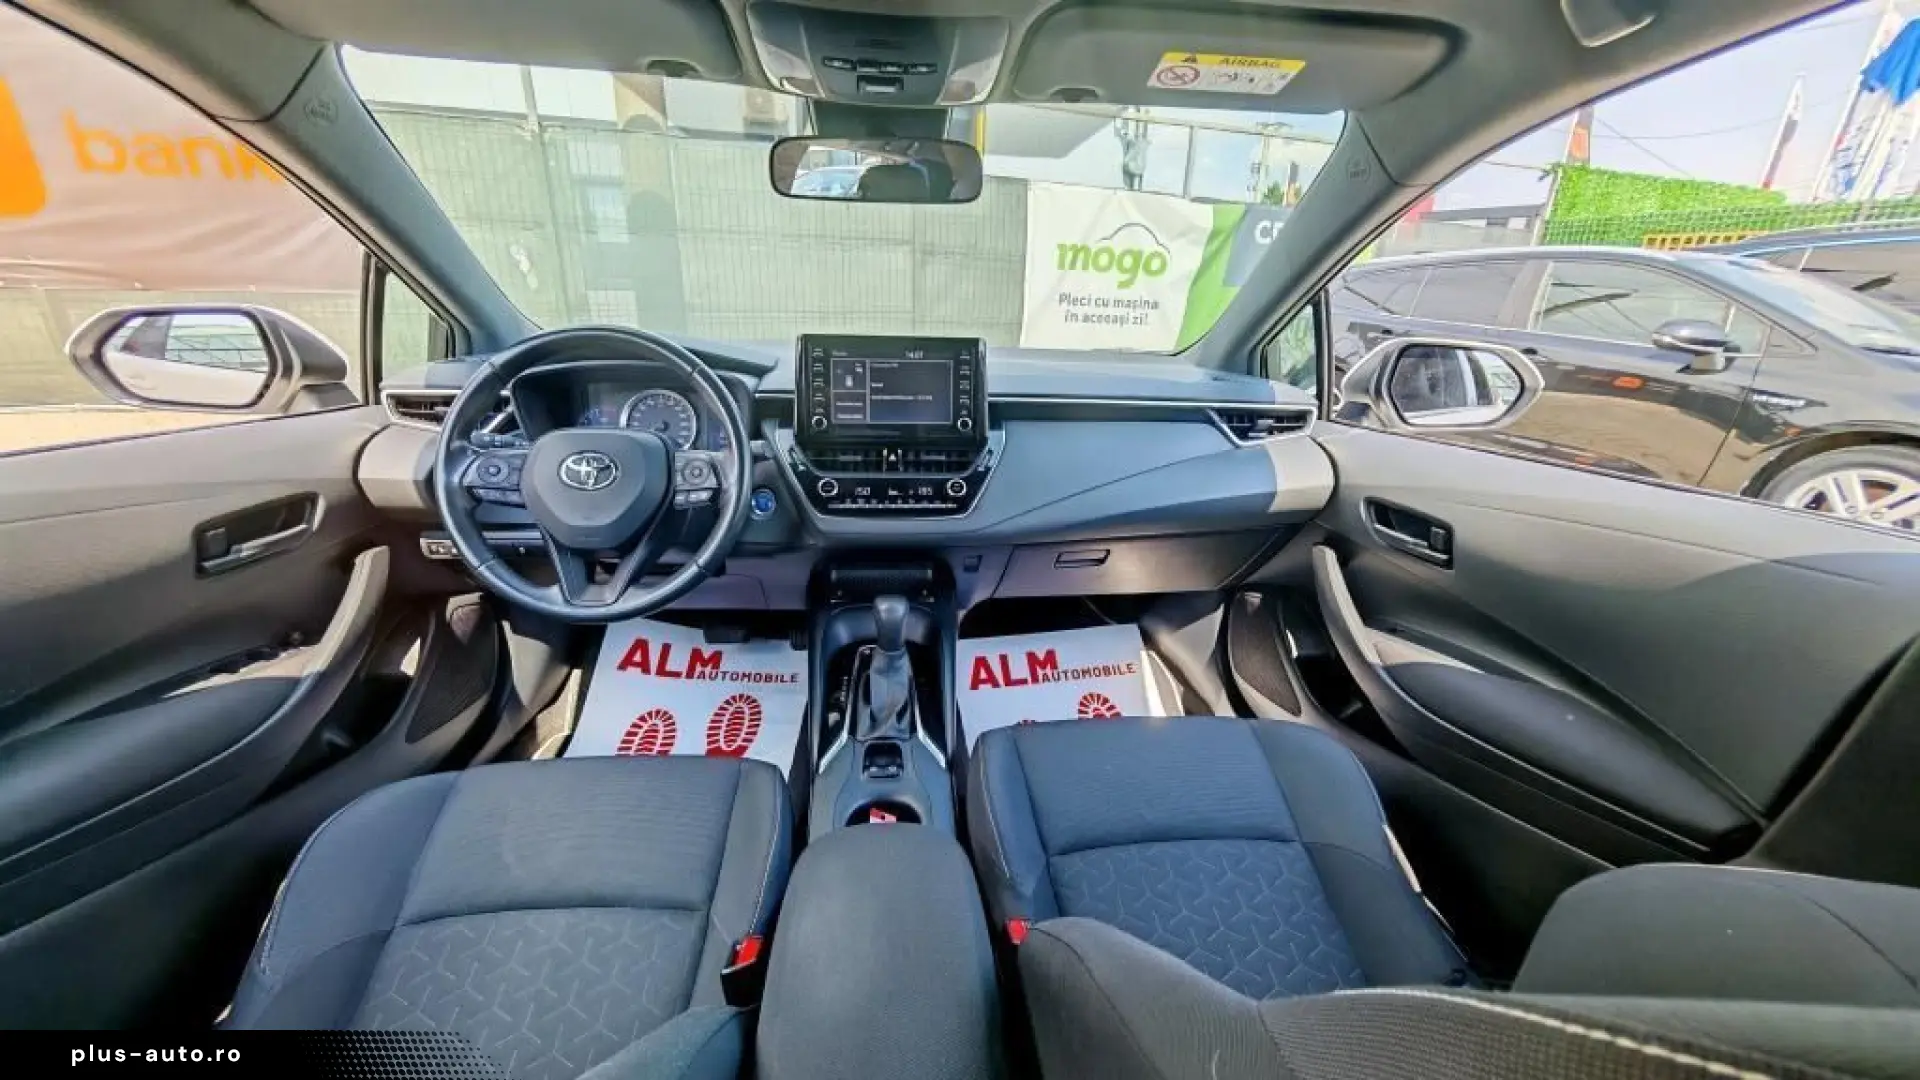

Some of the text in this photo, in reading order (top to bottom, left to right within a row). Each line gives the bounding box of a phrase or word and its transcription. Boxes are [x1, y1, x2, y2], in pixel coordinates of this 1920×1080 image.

[1056, 242, 1168, 289] mogo
[1058, 292, 1092, 307] Pleci
[1094, 297, 1110, 308] cu
[616, 637, 800, 683] ALM AUTOMOBILE
[969, 648, 1137, 690] ALM AUTOMOBILE
